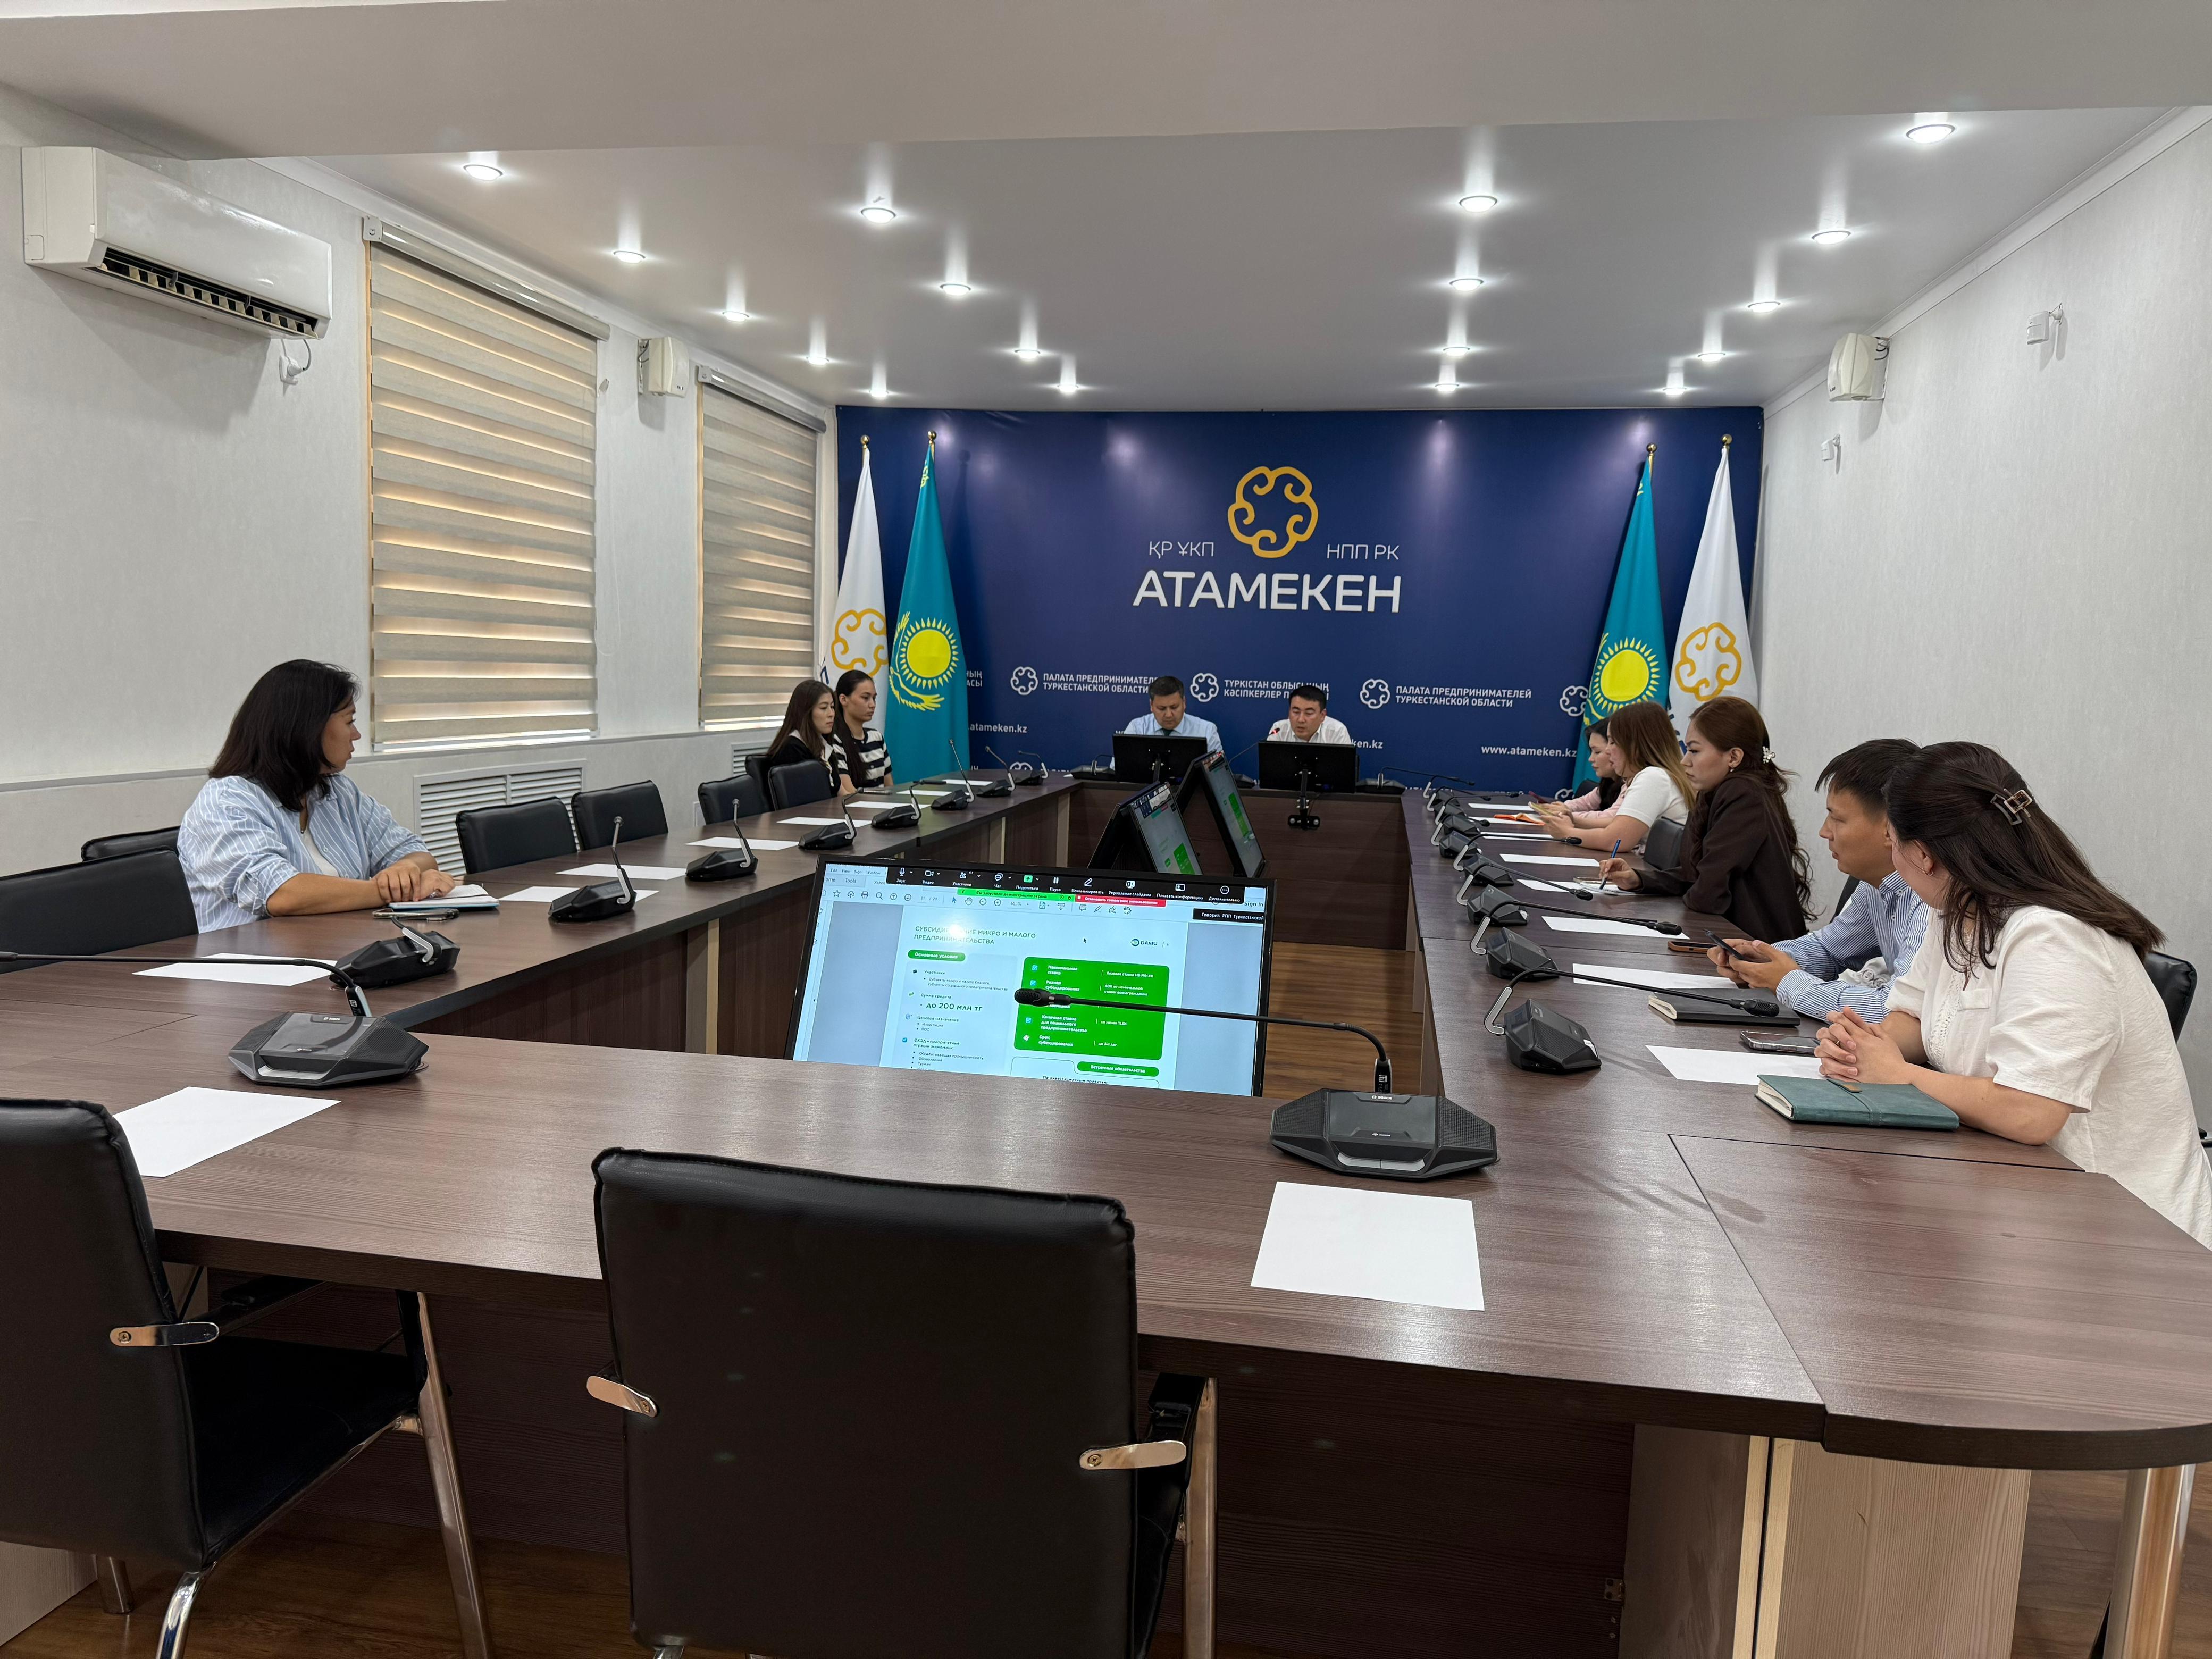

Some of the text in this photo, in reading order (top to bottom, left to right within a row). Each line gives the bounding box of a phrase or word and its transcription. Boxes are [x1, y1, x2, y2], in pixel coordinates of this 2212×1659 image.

[1149, 541, 1214, 559] ҚР ҰКП
[1327, 544, 1400, 560] НПП РК
[1133, 569, 1402, 613] АТАМЕКЕН
[1043, 673, 1158, 685] ПАЛАТА ПРЕДПРИНИМАТЕЛ
[1224, 680, 1269, 689] ТҮРКІСТАН
[1043, 682, 1149, 694] ТУРКЕСТАНСКОЙ ОБЛАСТИ
[1224, 689, 1281, 699] КӘСІПКЕРЛЕР
[1396, 685, 1532, 699] ПАЛАТА ПРЕДПРИНИМАТЕЛЕЙ
[1395, 696, 1513, 707] ТУРКЕСТАНСКОЙ ОБЛАСТИ
[968, 723, 1028, 733] .atameken.kz
[1481, 745, 1577, 758] www.atameken.kz
